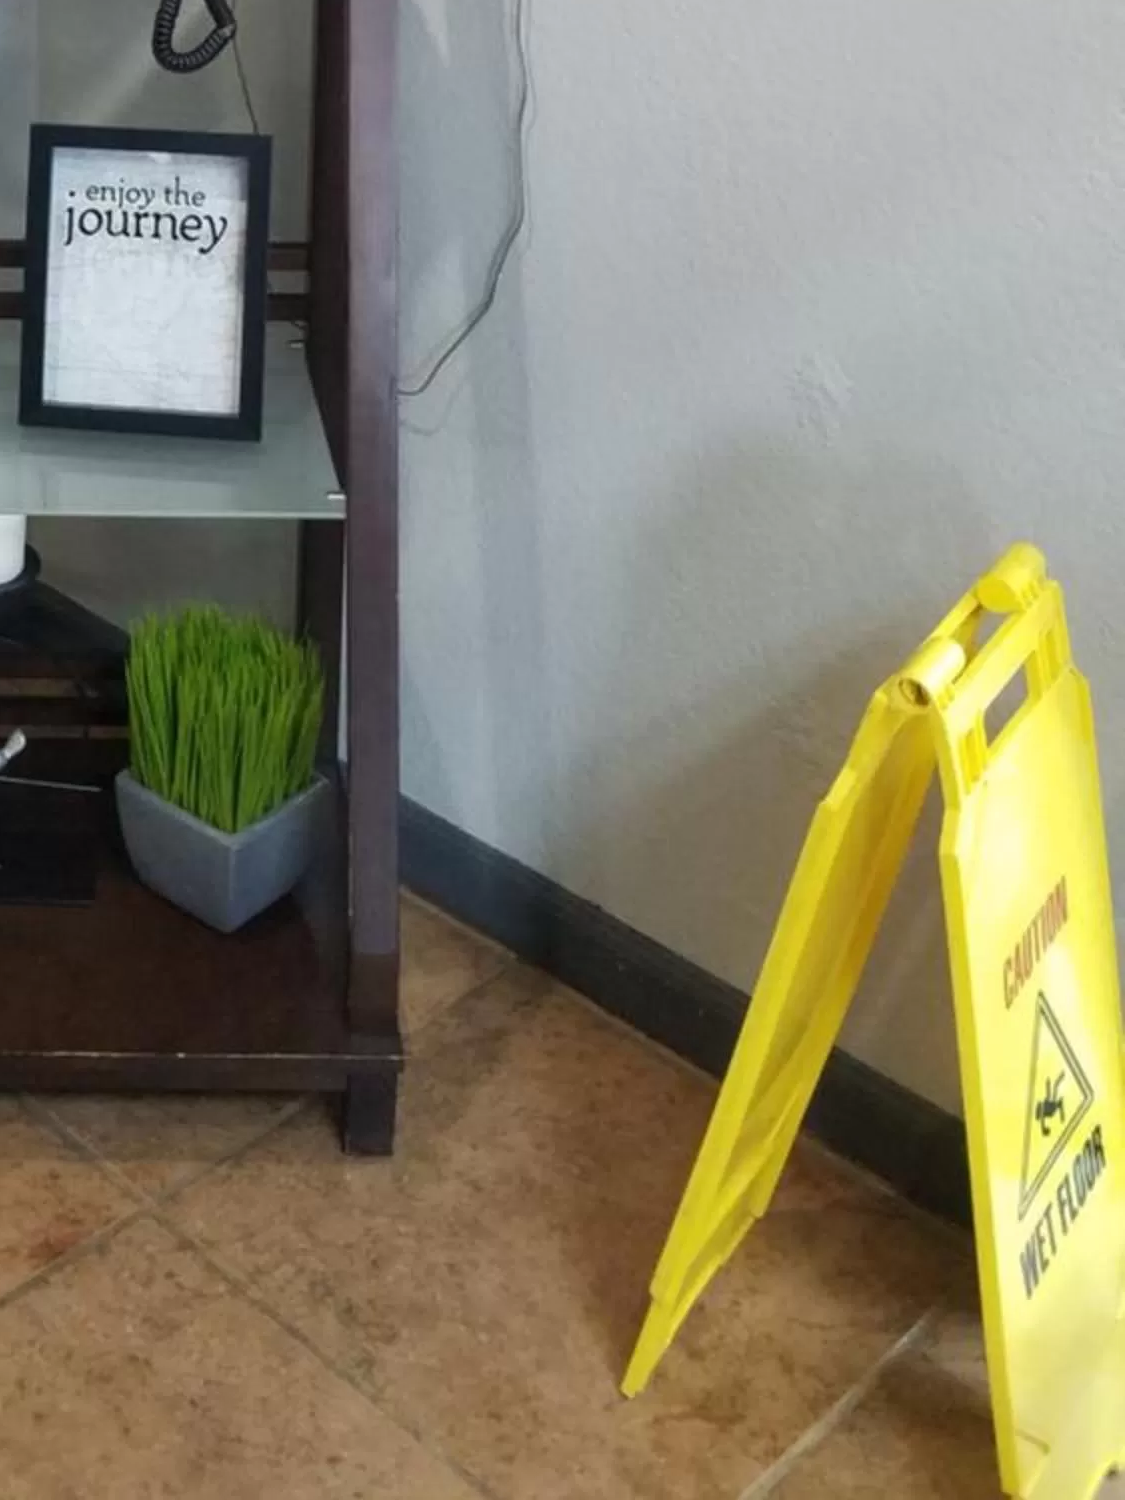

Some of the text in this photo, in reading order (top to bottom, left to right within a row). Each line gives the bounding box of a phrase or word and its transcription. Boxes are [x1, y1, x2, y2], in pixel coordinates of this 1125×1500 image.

[64, 191, 228, 254] journey
[86, 176, 207, 210] enjoy the
[1003, 874, 1068, 1011] CAUTION
[1020, 1124, 1106, 1301] WET FLOOR
